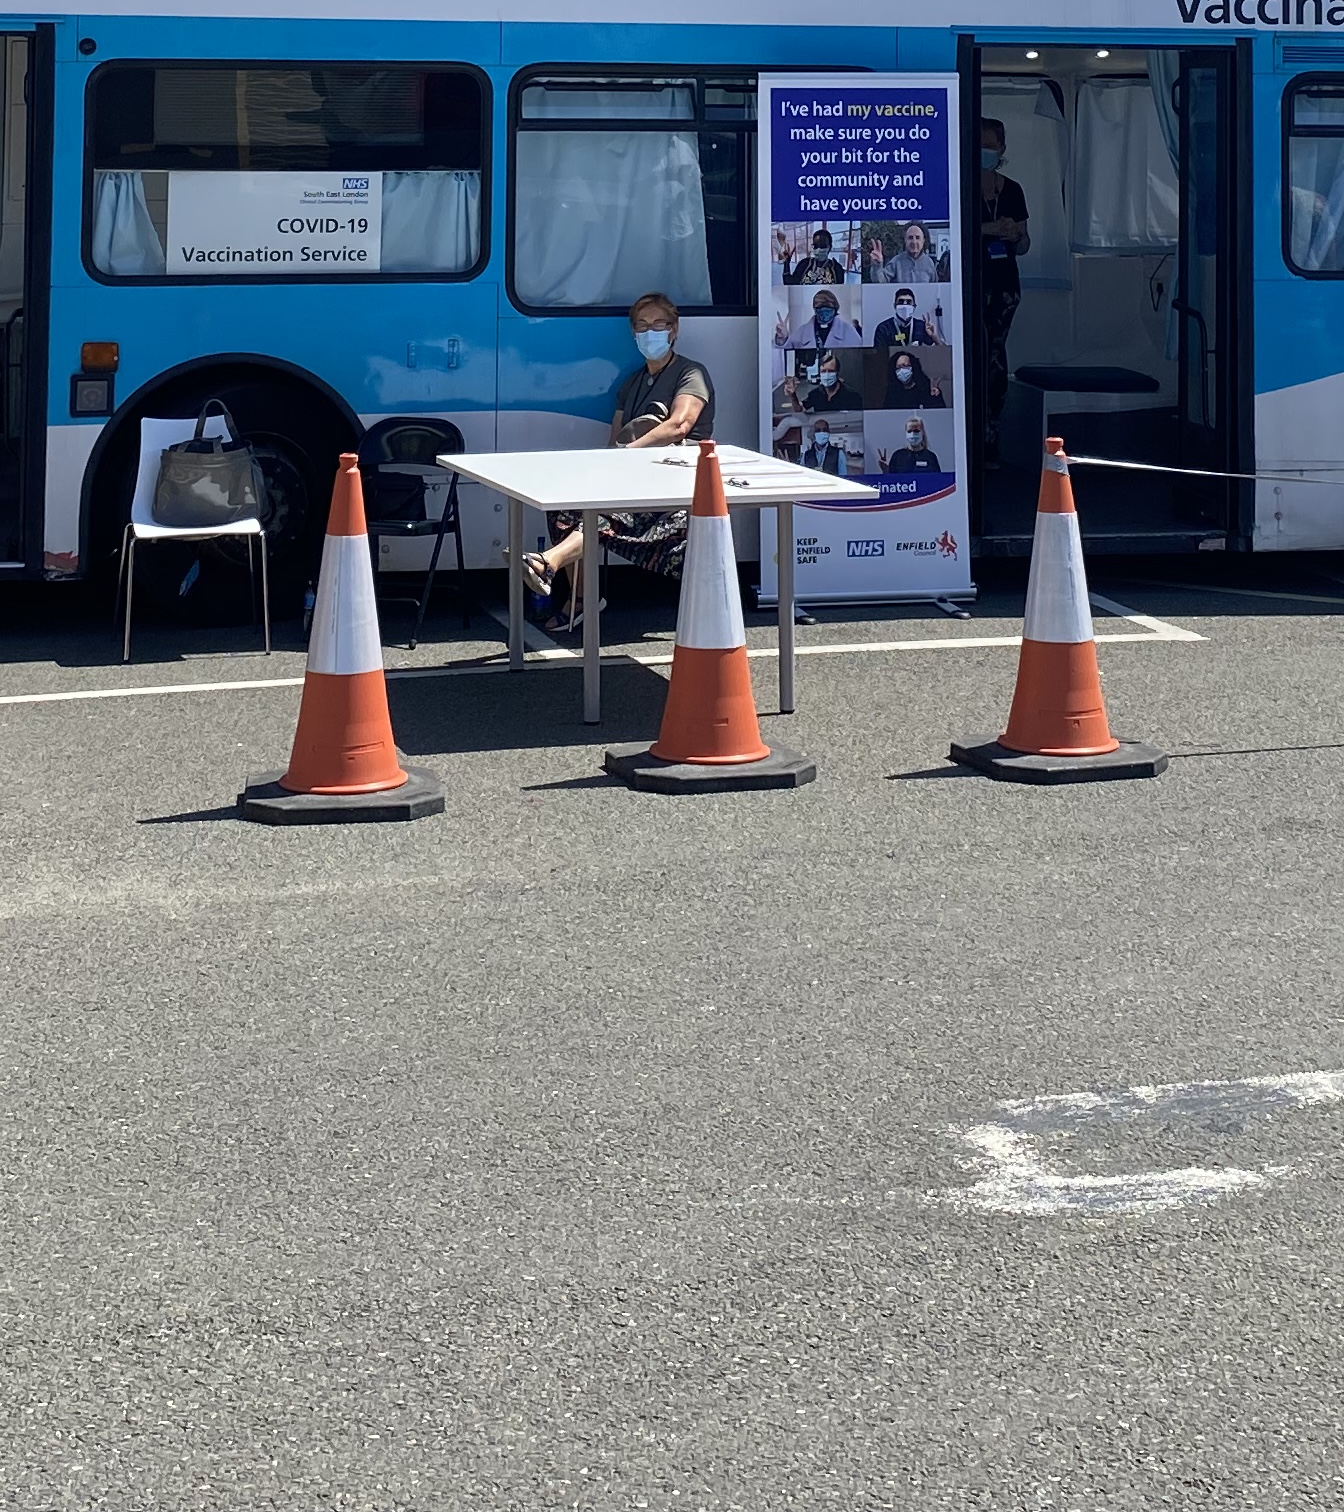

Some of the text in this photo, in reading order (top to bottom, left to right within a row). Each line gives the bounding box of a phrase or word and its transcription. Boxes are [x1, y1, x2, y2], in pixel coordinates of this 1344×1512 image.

[812, 100, 843, 117] had
[847, 104, 872, 120] my
[875, 101, 939, 119] vaccine,
[790, 123, 930, 144] make sure you do
[800, 147, 920, 168] your bit for the
[343, 178, 368, 189] NHS
[797, 170, 924, 191] community and
[303, 190, 369, 198] South East London
[800, 194, 922, 215] have yours too.
[276, 218, 369, 234] COVID-19
[181, 245, 368, 263] Vaccination Service
[796, 537, 818, 546] KEEP
[848, 541, 884, 557] NHS
[895, 541, 937, 551] ENFIELD
[796, 546, 831, 556] ENFIELD
[796, 555, 818, 565] SAFE
